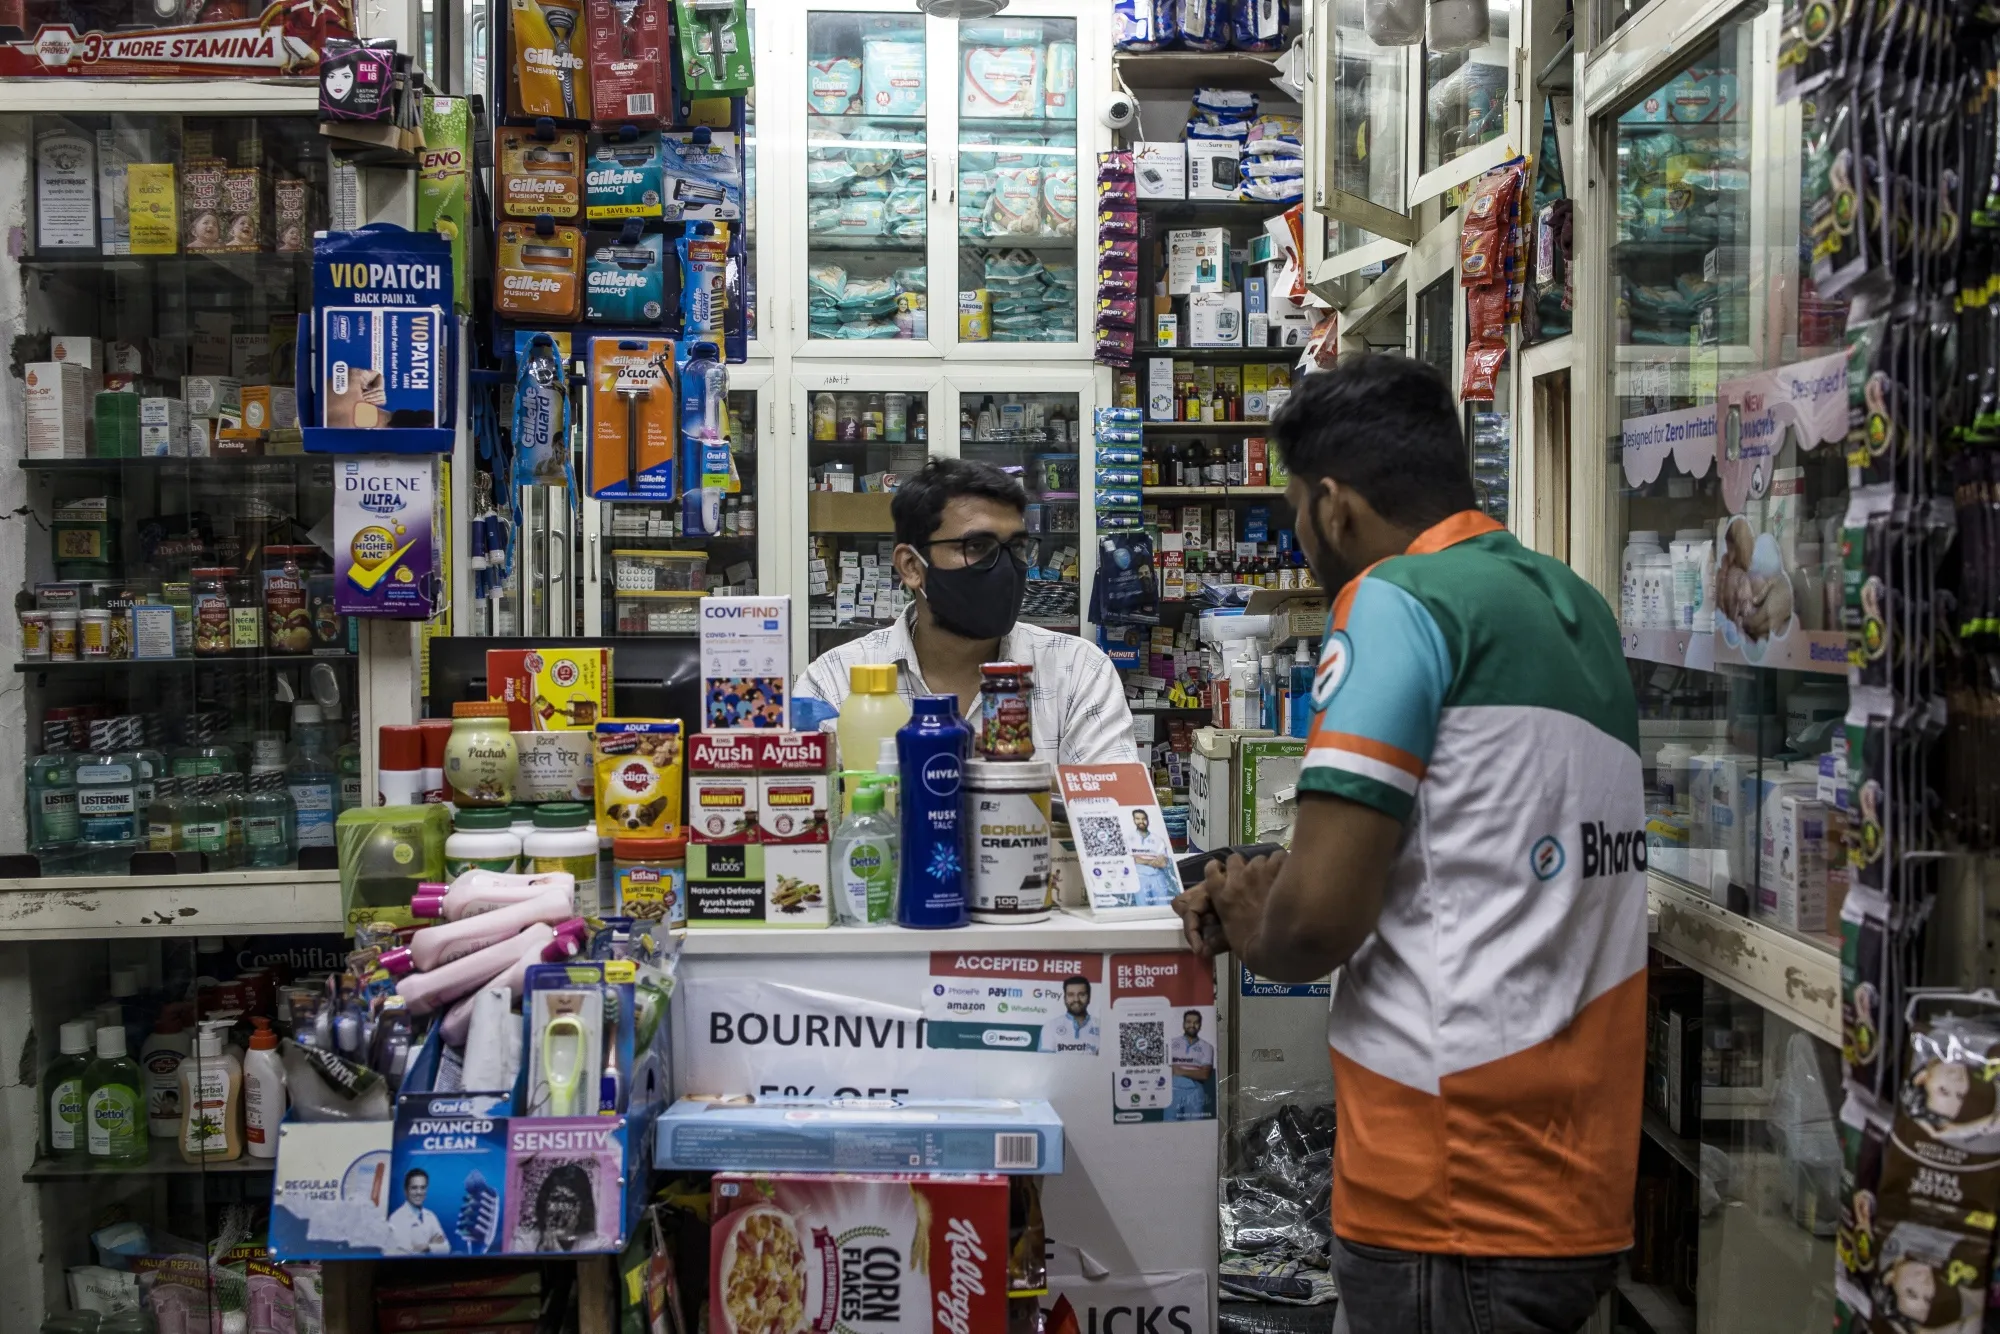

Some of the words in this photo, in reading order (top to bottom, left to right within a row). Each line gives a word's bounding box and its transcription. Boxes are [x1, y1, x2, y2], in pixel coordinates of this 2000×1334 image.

[40, 47, 71, 55] PROVEN
[117, 40, 164, 57] MORE
[169, 36, 275, 59] STAMINA
[524, 47, 584, 70] Gillette
[359, 63, 378, 72] ELLE
[611, 62, 638, 71] Gillette
[1196, 141, 1223, 149] AccuSure
[424, 150, 462, 168] ENO
[586, 169, 643, 187] Gillette
[508, 178, 565, 194] Gillette
[590, 184, 626, 195] MACH3
[193, 199, 216, 209] 555
[231, 201, 251, 212] 555
[509, 204, 517, 213] 4
[527, 205, 545, 214] SAVE
[546, 205, 556, 214] Rs.
[557, 205, 571, 214] 150
[606, 206, 624, 216] SAVE
[625, 206, 635, 215] Rs.
[637, 205, 645, 214] 21
[714, 207, 723, 218] 2
[1105, 220, 1125, 228] moov
[330, 263, 441, 290] VIOPATCH
[587, 271, 647, 288] Gillette
[503, 275, 561, 293] Gillette
[590, 286, 628, 297] MACH3
[354, 292, 380, 304] BACK
[382, 294, 402, 304] PAIN
[405, 294, 417, 305] XL
[502, 297, 510, 308] 2
[692, 287, 703, 323] Gillette
[701, 293, 709, 321] Guard
[587, 306, 594, 317] 2
[411, 315, 429, 390] VIOPATCH
[336, 363, 345, 374] 10
[617, 365, 660, 380] O'CLOCK
[521, 385, 539, 449] Gillette
[535, 396, 551, 446] Guard
[648, 434, 668, 442] Shaving
[1623, 429, 1653, 451] Designed
[1653, 427, 1665, 443] for
[1666, 421, 1684, 442] Zero
[647, 440, 665, 448] System
[706, 452, 727, 461] Oral-B
[638, 474, 667, 483] Gillette
[345, 477, 420, 492] DIGENE
[362, 493, 402, 506] ULTRA
[363, 534, 385, 542] 50%
[354, 542, 393, 551] HIGHER
[360, 551, 383, 559] ANC
[705, 606, 779, 619] COVIFIND
[705, 632, 736, 640] COVID-19
[624, 723, 651, 732] ADULT
[467, 745, 507, 760] Pachak
[694, 744, 753, 765] Ayush
[762, 742, 822, 764] Ayush
[714, 761, 739, 769] Kwath
[782, 760, 808, 768] Kwath
[926, 769, 960, 780] NIVEA
[1065, 772, 1079, 783] Ek
[1080, 771, 1118, 783] Bharat
[1068, 781, 1082, 792] Ek
[1082, 781, 1101, 792] QR
[81, 794, 130, 806] LISTERINE
[701, 794, 743, 804] IMMUNITY
[769, 793, 812, 804] IMMUNITY
[85, 804, 106, 812] COOL
[107, 803, 126, 812] MINT
[928, 810, 957, 821] MUSK
[933, 820, 954, 830] TALC
[981, 836, 1049, 849] CREATINE
[711, 862, 740, 872] KUDOS
[850, 855, 882, 868] Dettol
[630, 870, 659, 883] kissan
[625, 887, 647, 895] PEANUT
[647, 886, 665, 894] BUTTER
[690, 886, 726, 895] Nature's
[727, 886, 763, 895] Defence
[699, 898, 723, 908] Ayush
[724, 898, 755, 907] Kwath
[995, 896, 1017, 906] 100
[725, 906, 751, 914] Powder
[955, 955, 1040, 973] ACCEPTED
[1042, 958, 1082, 975] HERE
[1117, 964, 1132, 977] Ek
[1134, 963, 1179, 976] Bharat
[1117, 976, 1133, 989] Ek
[1134, 976, 1155, 988] QR
[948, 986, 981, 997] PhonePe
[1045, 989, 1063, 1002] Pay
[1250, 984, 1292, 995] AcneStar
[946, 1001, 986, 1012] amazon
[1010, 1004, 1048, 1014] WhatsApp
[998, 1033, 1029, 1043] BharatPe
[193, 1085, 224, 1095] Herbal
[95, 1107, 125, 1120] Dettol
[408, 1120, 493, 1136] ADVANCED
[423, 1136, 477, 1151] CLEAN
[284, 1179, 339, 1191] REGULAR
[249, 1262, 270, 1276] VALUE
[841, 1247, 862, 1322] FLAKES
[862, 1245, 902, 1323] CORN
